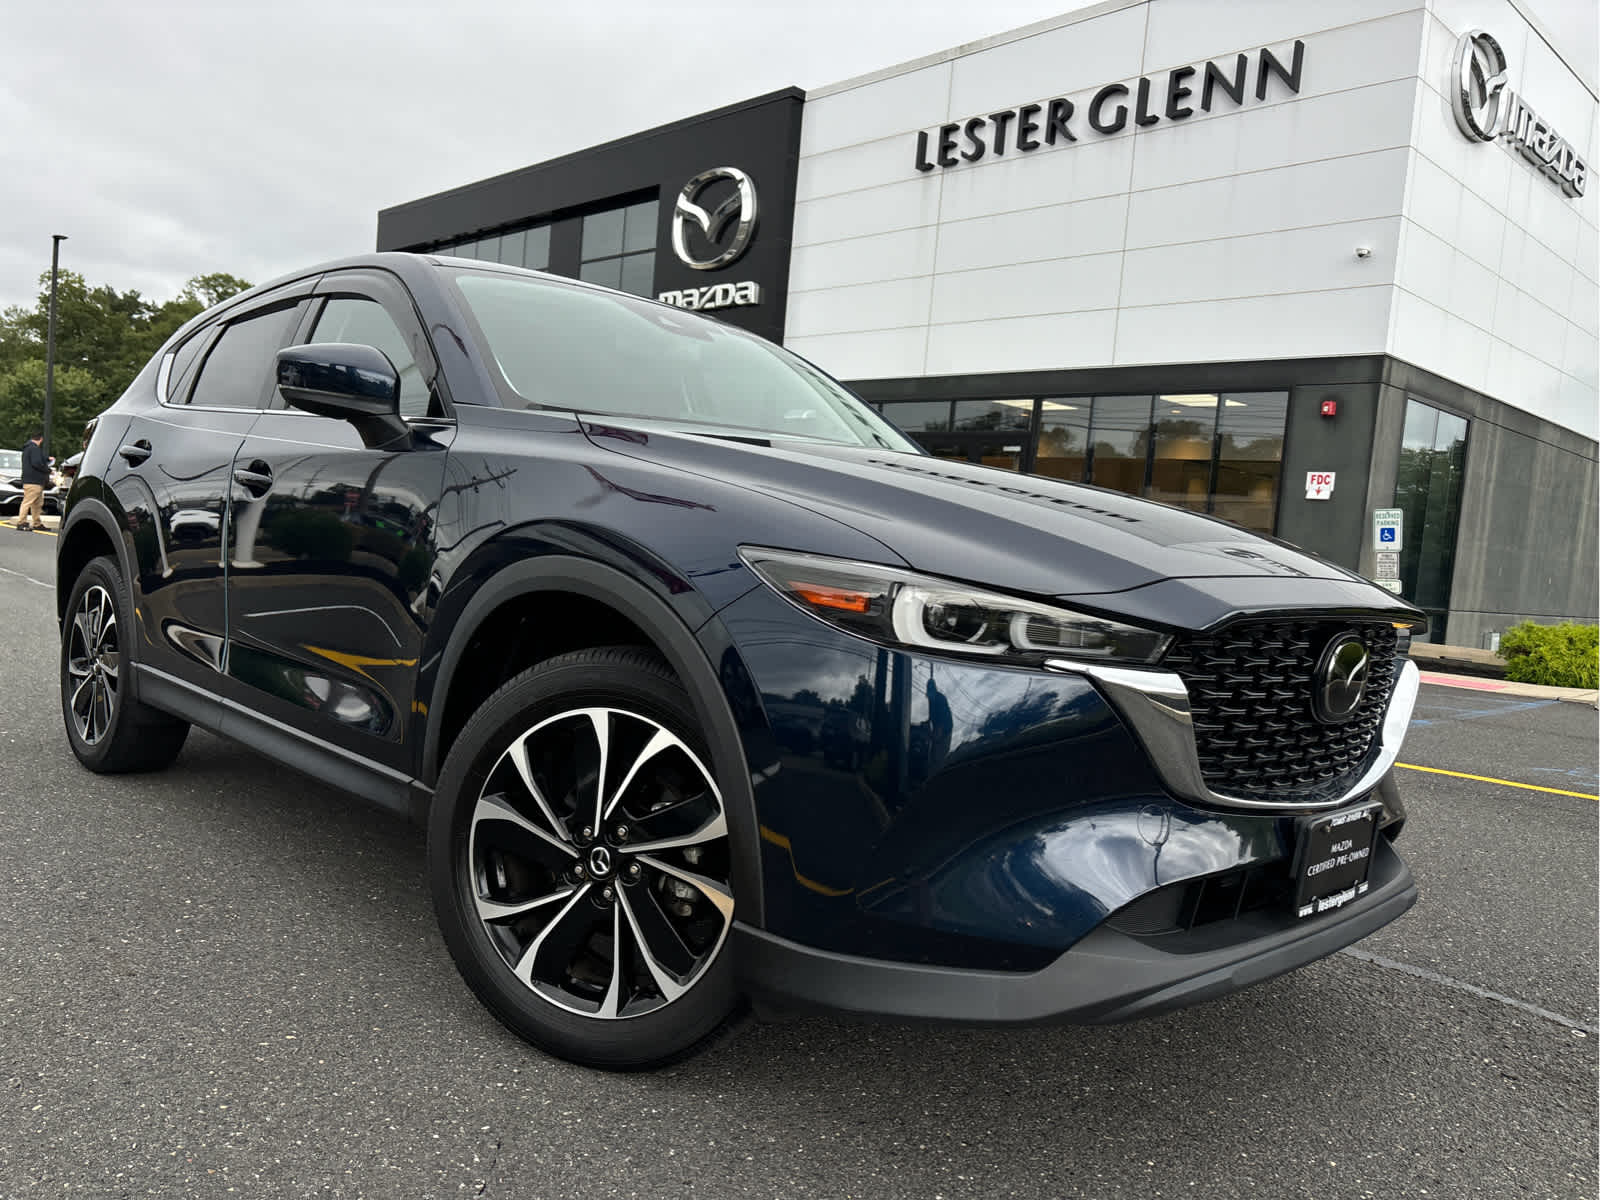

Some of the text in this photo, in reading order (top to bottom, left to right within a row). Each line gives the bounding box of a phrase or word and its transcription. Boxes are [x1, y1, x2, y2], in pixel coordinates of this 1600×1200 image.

[915, 39, 1305, 172] LESTER GLENN
[1310, 474, 1331, 485] FDC
[1331, 840, 1353, 853] MAZDA
[1307, 847, 1370, 877] CERTIFIED PRE-OWNED
